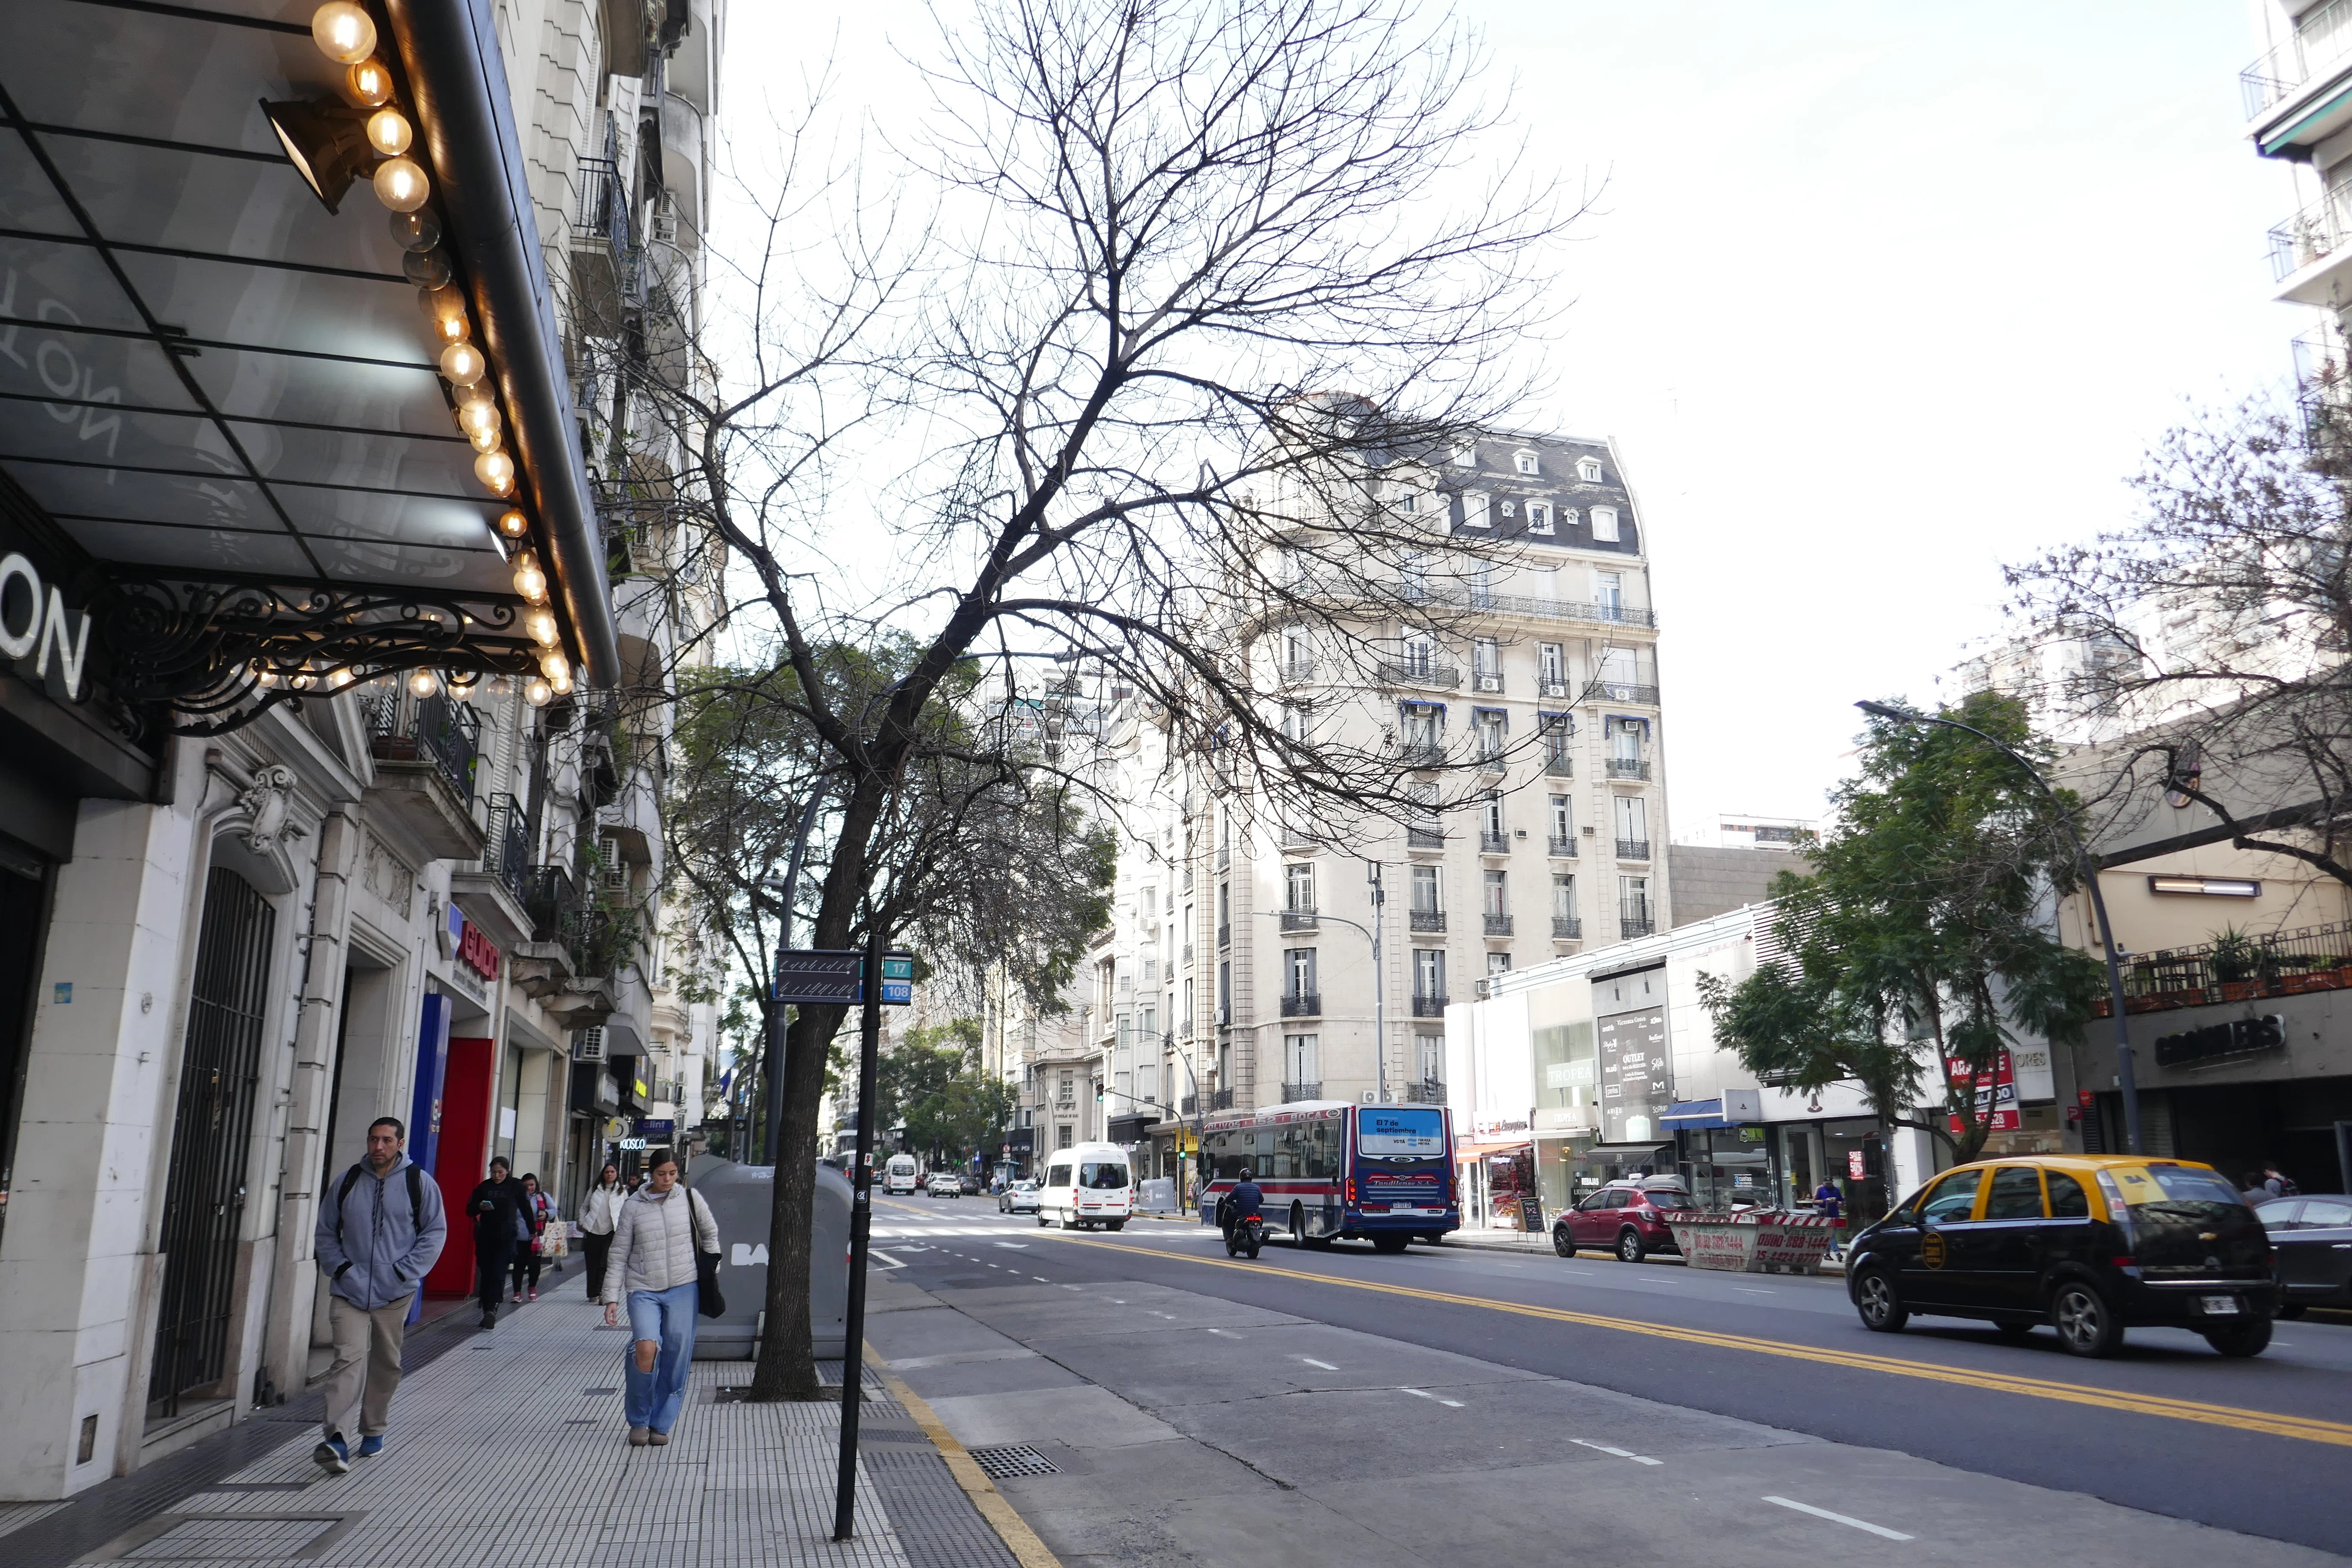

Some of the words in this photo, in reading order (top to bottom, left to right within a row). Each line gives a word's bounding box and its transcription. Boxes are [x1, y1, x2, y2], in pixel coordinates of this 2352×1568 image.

[465, 920, 500, 982] GUIDO
[893, 963, 906, 974] 17
[888, 986, 909, 997] 108
[1623, 1053, 1645, 1063] OUTLET
[1548, 1066, 1592, 1082] TROPEA
[1207, 1120, 1240, 1131] OLIVOS
[1252, 1116, 1276, 1126] 152
[1291, 1111, 1322, 1122] BOCA
[1553, 1112, 1577, 1124] TROPEA
[643, 1120, 665, 1129] clint
[1501, 1119, 1528, 1134] Energizer
[619, 1138, 645, 1150] KIOSCO
[1581, 1177, 1599, 1186] REBAJAS
